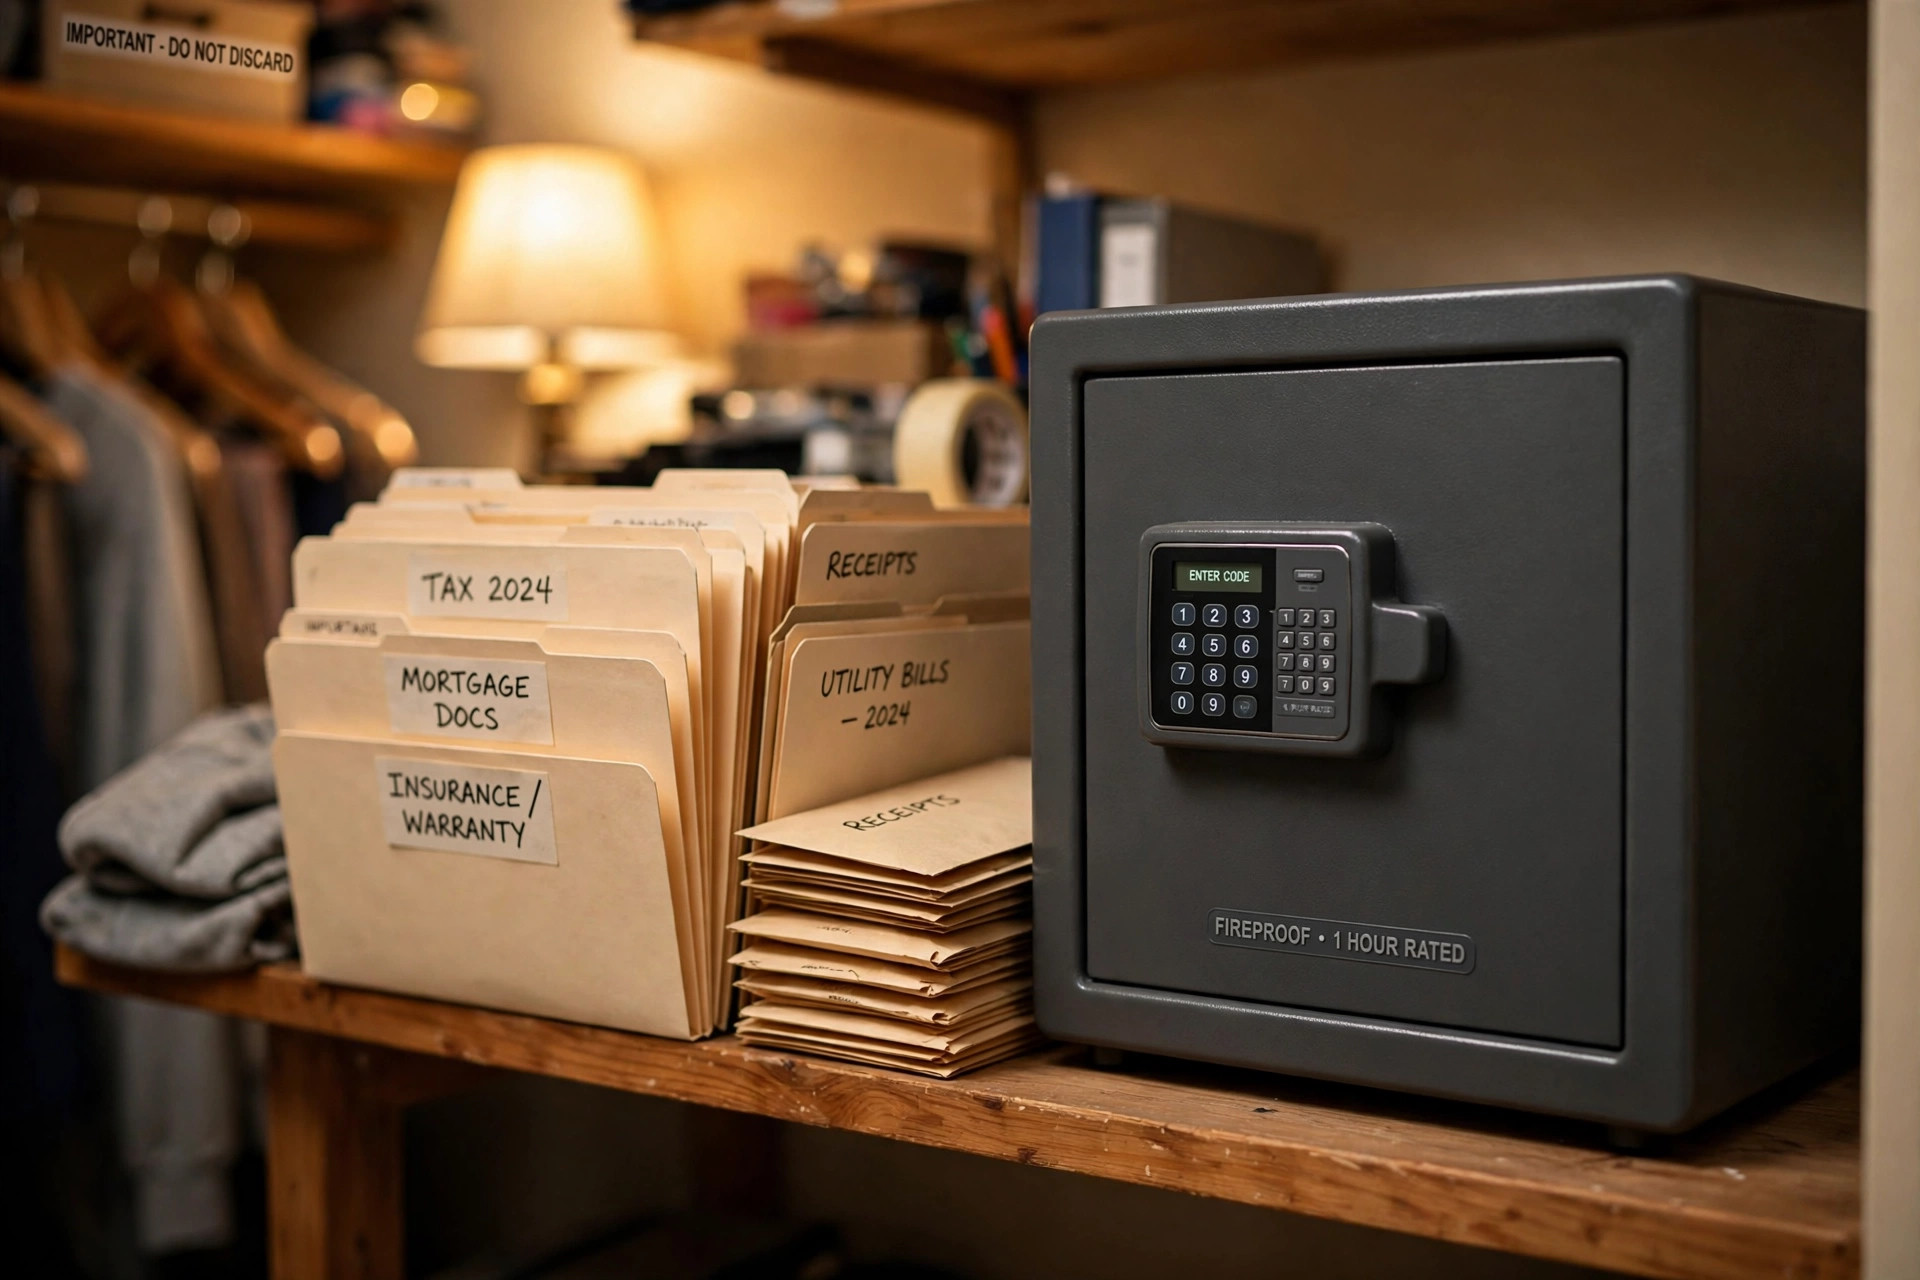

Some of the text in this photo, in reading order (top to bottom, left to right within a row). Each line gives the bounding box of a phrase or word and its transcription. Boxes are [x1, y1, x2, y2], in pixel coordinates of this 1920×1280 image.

[66, 21, 155, 54] IMPORTANT
[168, 36, 191, 59] DO
[194, 40, 226, 64] NOT
[229, 45, 294, 73] DISCARD
[826, 550, 917, 580] RECEIPTS
[1189, 569, 1250, 583] ENTER CODE
[421, 572, 553, 604] TAX 2024
[1179, 607, 1251, 624] 1 2 3
[1303, 613, 1310, 624] 2
[1323, 613, 1330, 624] 3
[1178, 637, 1250, 654] 4 5 6
[1282, 635, 1330, 646] 4 5 6
[1178, 666, 1250, 684] 7 8 9
[1282, 657, 1329, 669] 7 8 9
[401, 667, 530, 698] MORTGAGE
[821, 659, 950, 698] UTILITY BILLS
[1282, 680, 1329, 692] 7 0 9
[433, 702, 499, 730] DOCS
[865, 700, 911, 730] 2024
[1177, 695, 1218, 712] 0 9
[842, 794, 960, 831] RECEIPTS
[402, 809, 526, 848] WARRANTY
[1215, 916, 1311, 945] FIREPROOF
[1333, 930, 1342, 950] 1
[1347, 931, 1399, 956] HOUR
[1404, 938, 1465, 964] RATED
